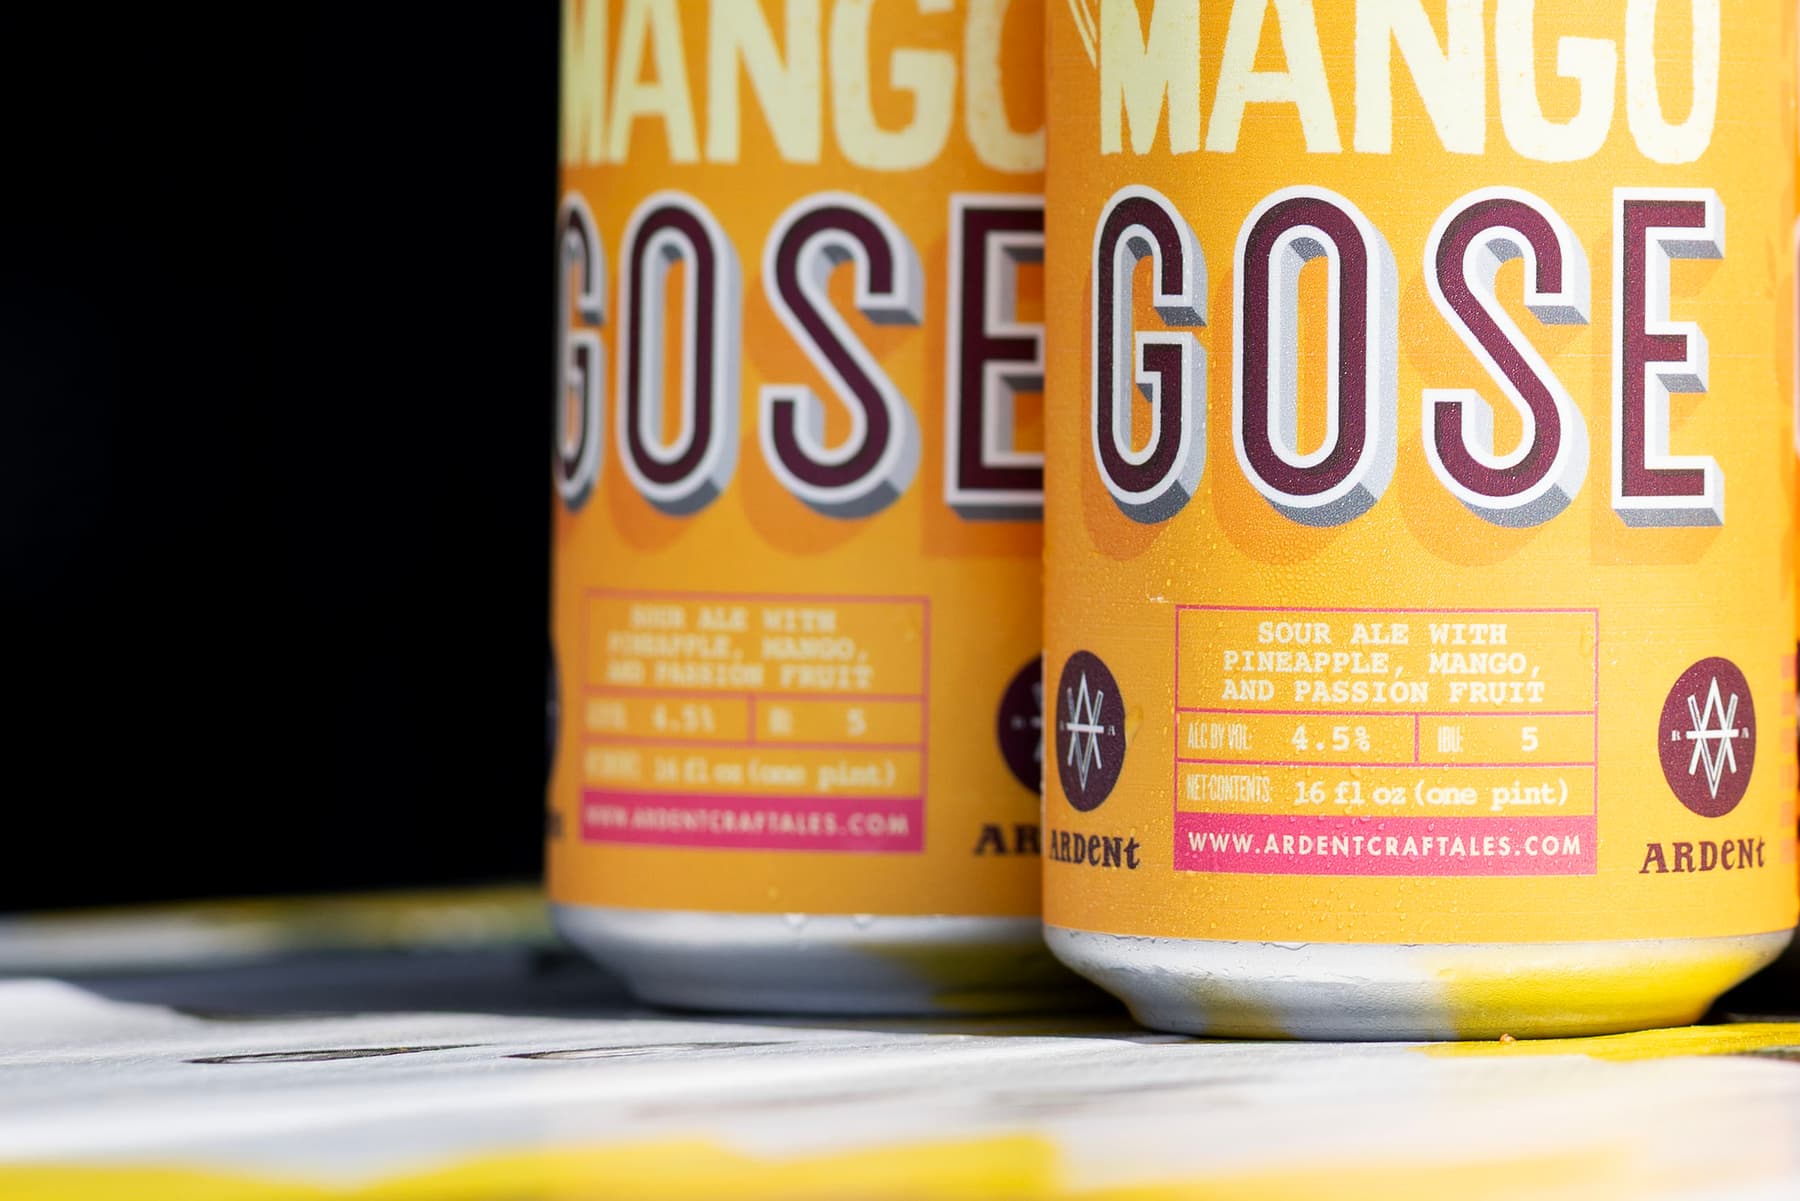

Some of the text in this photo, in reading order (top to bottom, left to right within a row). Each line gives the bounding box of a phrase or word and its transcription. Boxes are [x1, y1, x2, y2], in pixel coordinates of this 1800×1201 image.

[1091, 185, 1725, 527] GOSE
[699, 606, 748, 631] ALE
[762, 608, 837, 632] WITH
[1258, 621, 1507, 645] SOUR ALE WITH
[780, 664, 874, 689] FRUIT
[1223, 651, 1541, 678] PINEAPPLE, MANGO,
[1222, 680, 1544, 704] AND PASSION FRUIT
[1210, 723, 1225, 749] BY
[1292, 725, 1370, 752] 4.5%
[1521, 727, 1538, 751] 5
[1295, 781, 1325, 805] 16
[1334, 780, 1365, 805] fl
[1373, 787, 1406, 805] oz
[1415, 780, 1477, 807] (one
[1490, 778, 1568, 811] pint)
[1188, 831, 1581, 857] WWW.ARDENTCRAFTALES.COM
